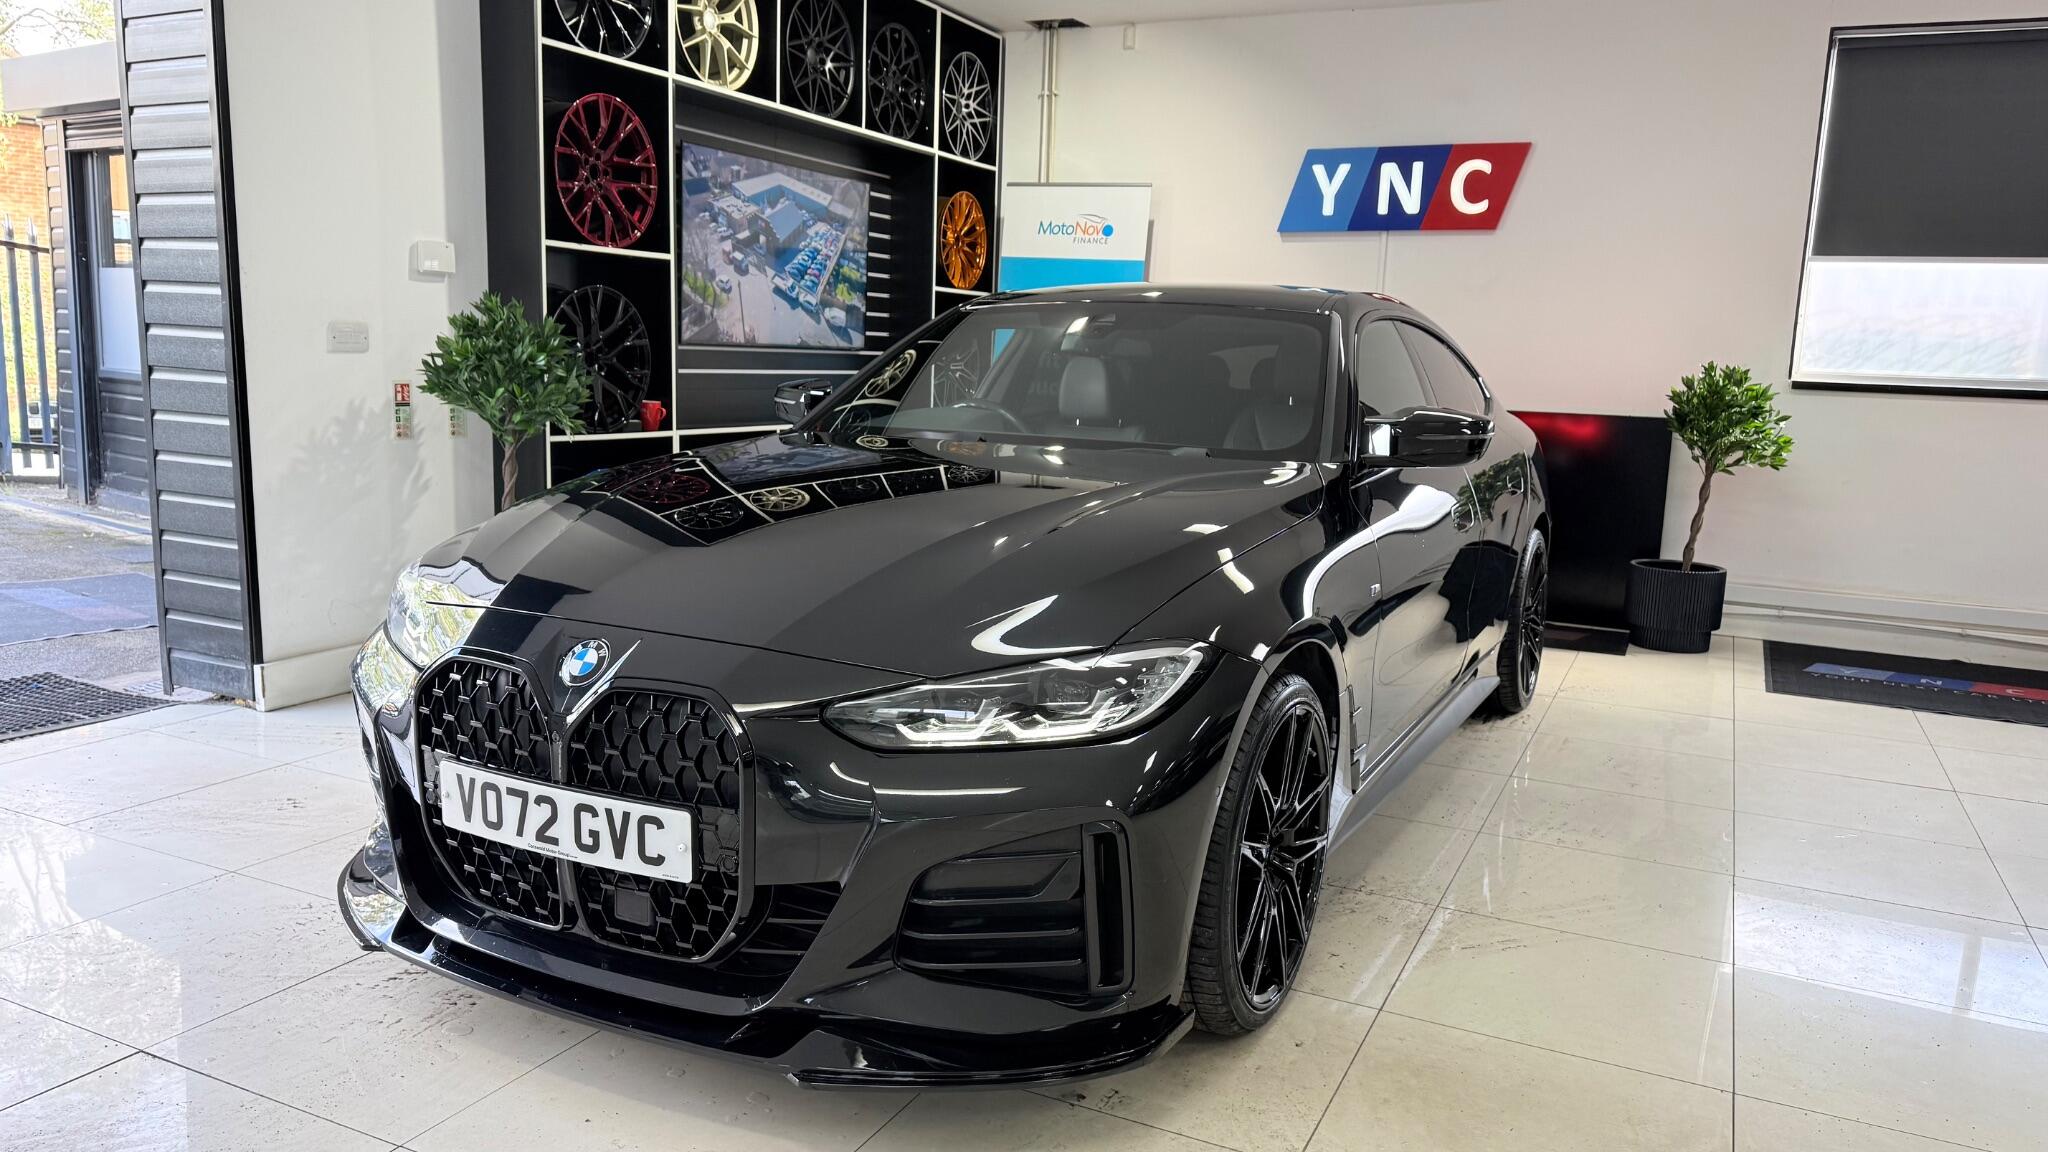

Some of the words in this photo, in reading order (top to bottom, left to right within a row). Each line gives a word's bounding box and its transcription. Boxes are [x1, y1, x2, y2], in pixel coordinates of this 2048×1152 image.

[1072, 236, 1109, 245] FINANCE
[1811, 673, 1869, 682] YOUR
[456, 773, 559, 846] VO72
[573, 802, 666, 866] GVC
